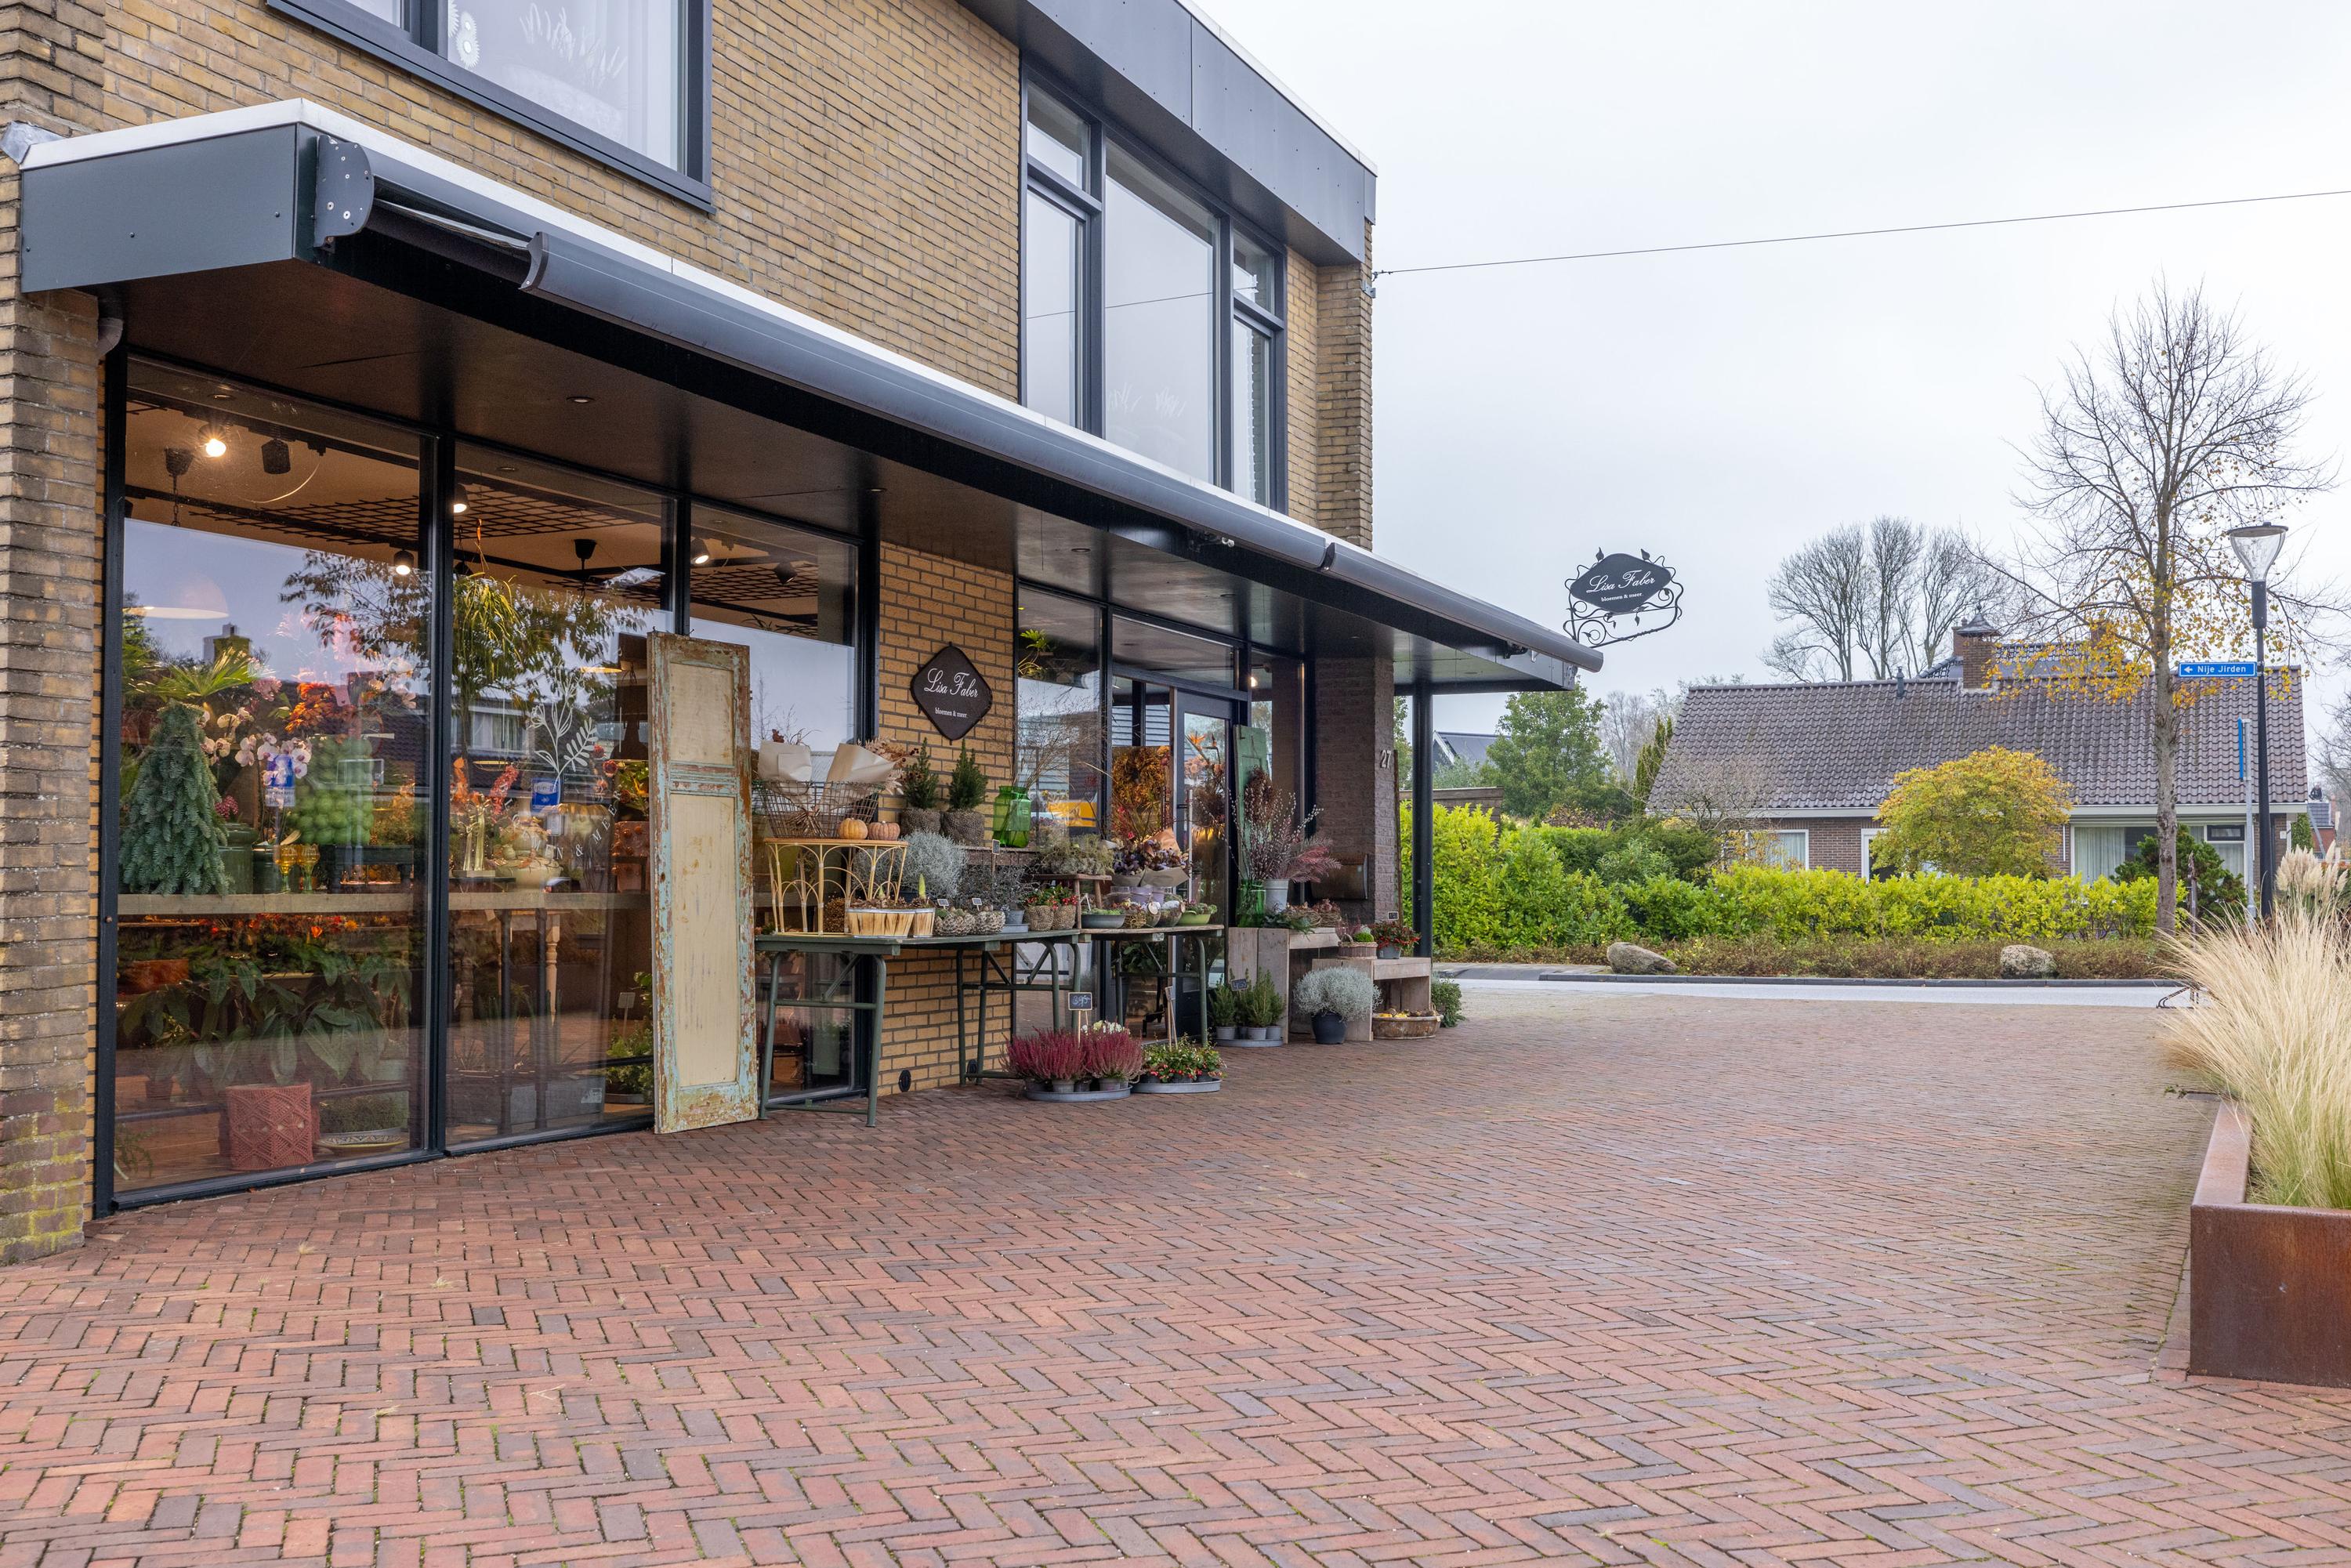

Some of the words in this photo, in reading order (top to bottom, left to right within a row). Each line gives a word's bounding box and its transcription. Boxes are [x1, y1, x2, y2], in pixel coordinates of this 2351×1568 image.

[1586, 574, 1616, 593] Lisa
[1618, 570, 1656, 588] Faber
[2197, 666, 2215, 675] Nije
[923, 668, 948, 693] Lisa
[949, 672, 979, 697] Faber
[935, 707, 953, 716] bloemen
[1381, 749, 1392, 769] 27
[575, 844, 584, 857] &
[591, 790, 622, 845] MEER
